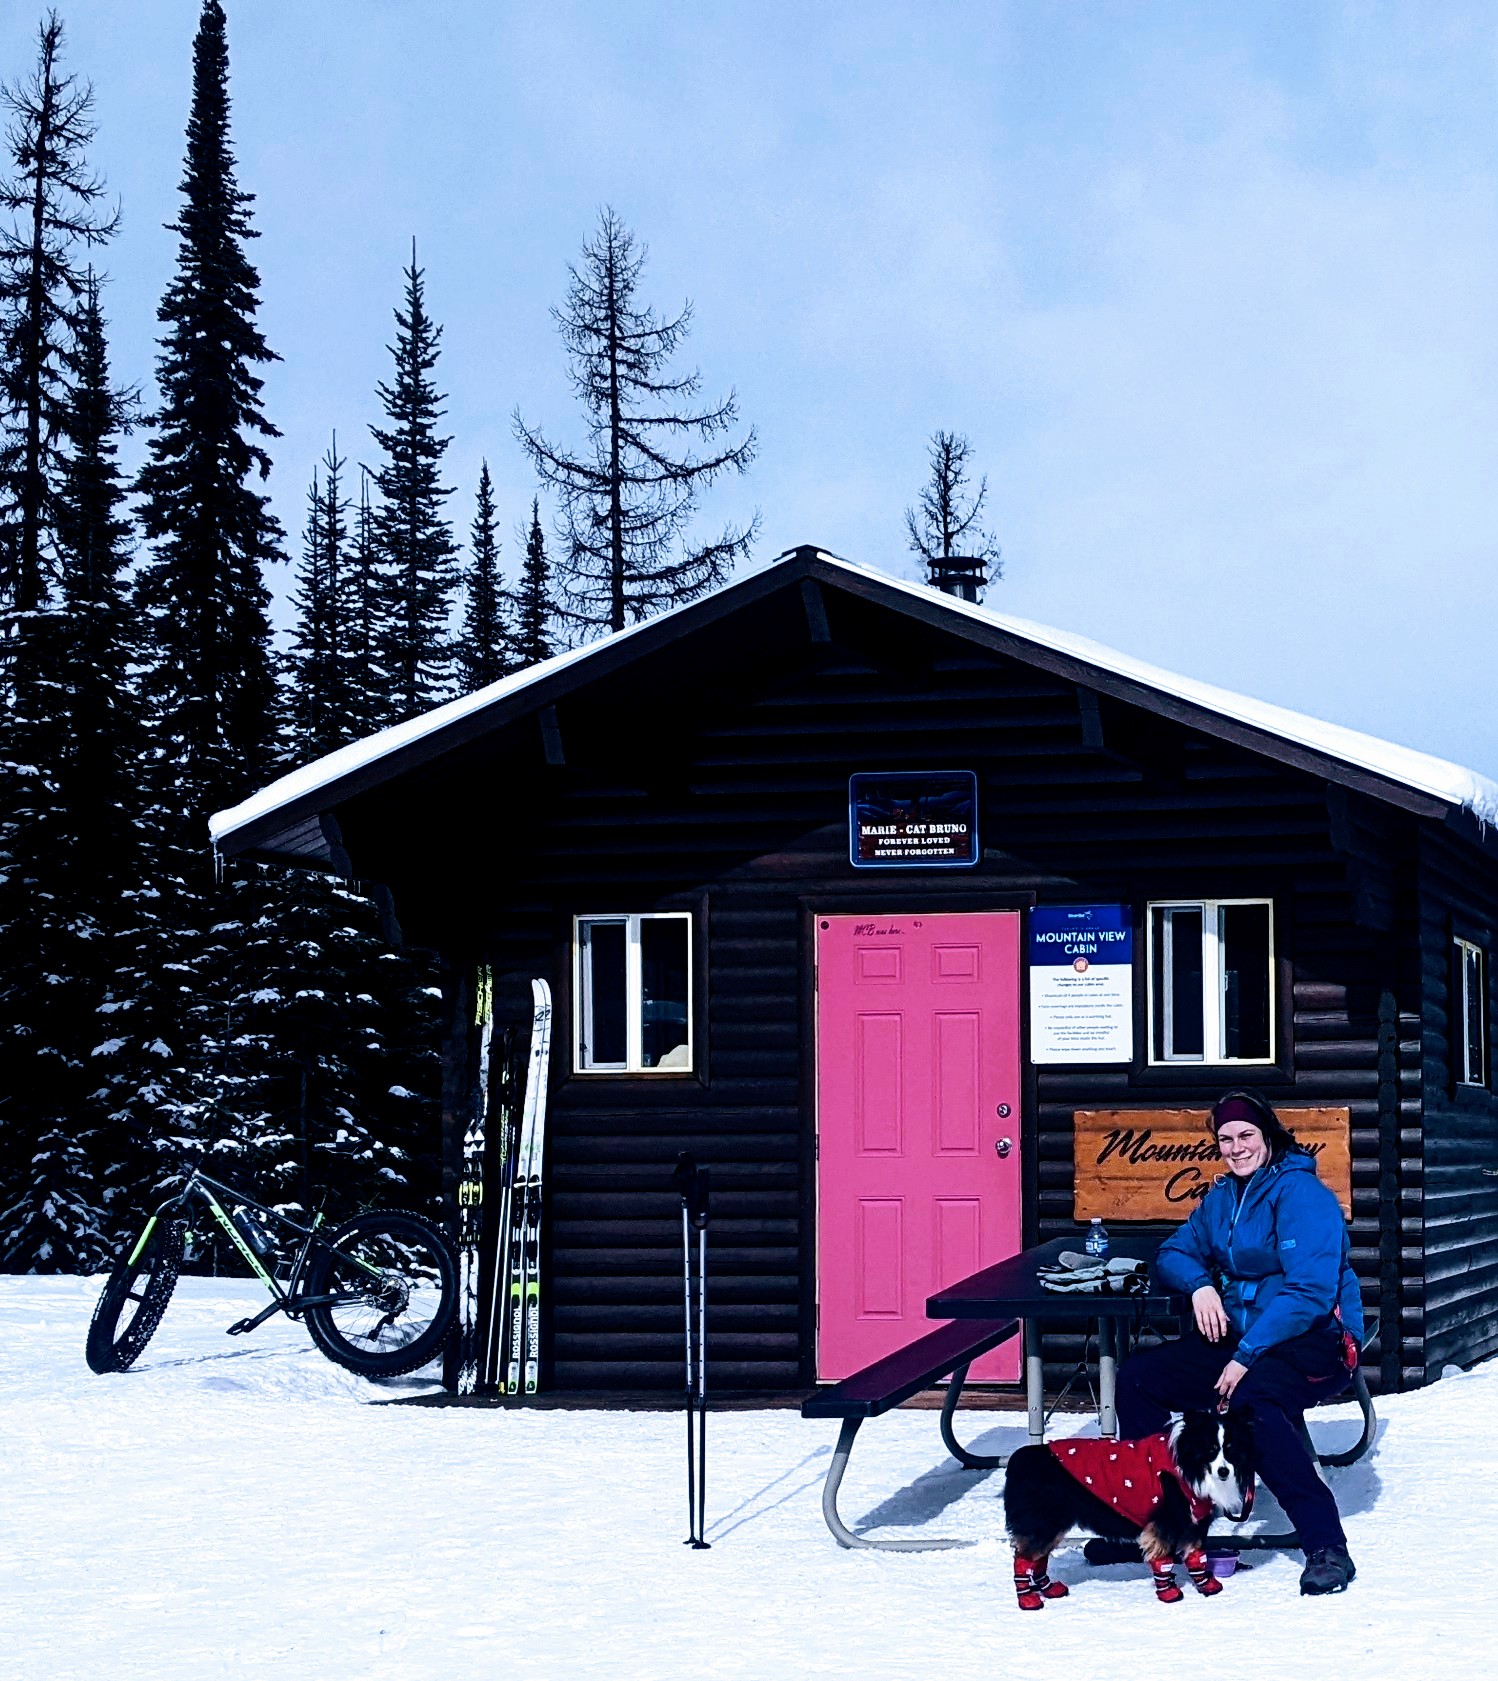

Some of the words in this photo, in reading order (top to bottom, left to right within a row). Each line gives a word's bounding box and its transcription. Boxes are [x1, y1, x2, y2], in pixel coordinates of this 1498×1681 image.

[862, 825, 896, 835] MARIE
[905, 824, 927, 834] CAT
[929, 823, 967, 834] BRUNO
[904, 848, 955, 856] FORGOTTEN
[1036, 931, 1095, 943] MOUNTAIN
[1098, 931, 1126, 942] VIEW
[1064, 943, 1097, 954] CABIN
[1096, 1129, 1222, 1165] Mounta
